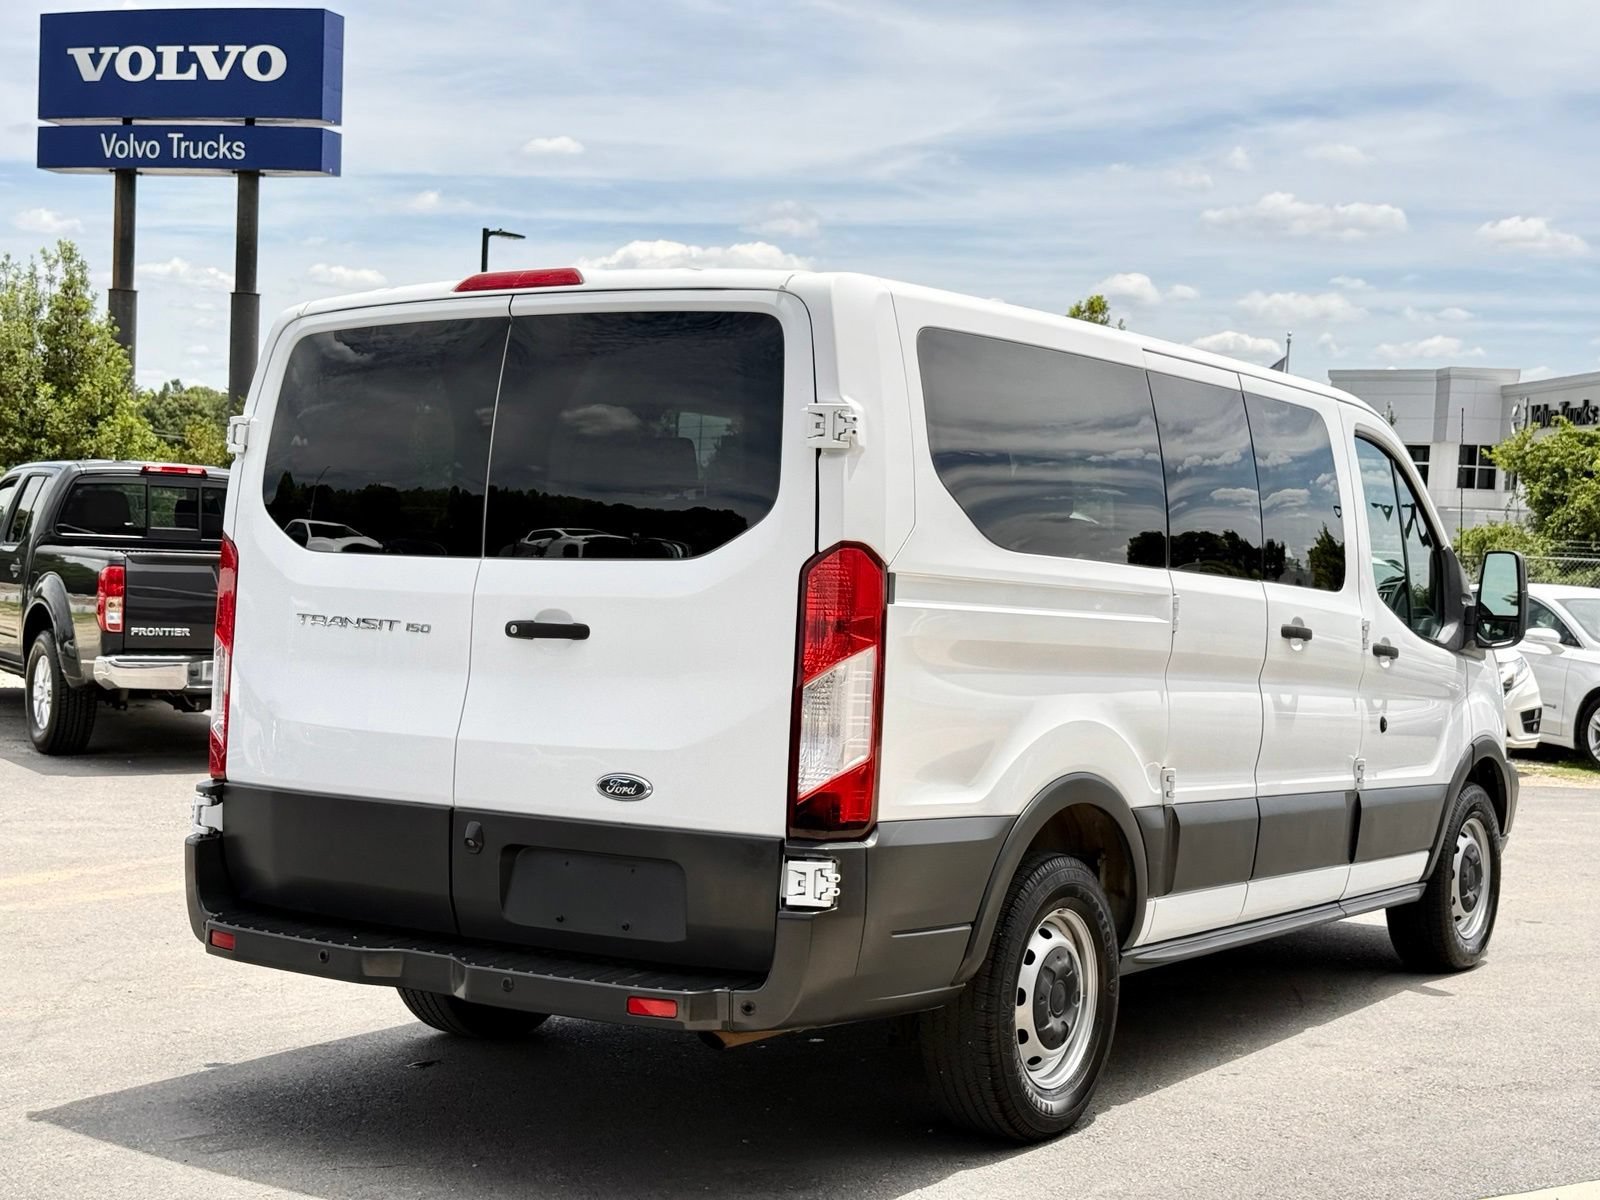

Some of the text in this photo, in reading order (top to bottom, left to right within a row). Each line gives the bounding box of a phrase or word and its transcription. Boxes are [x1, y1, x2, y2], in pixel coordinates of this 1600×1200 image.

[67, 44, 287, 82] VOLVO
[101, 133, 246, 160] Volvo Trucks
[130, 627, 190, 637] FRONTIER
[296, 613, 431, 634] TRANSIT 150
[606, 778, 638, 795] Ford
